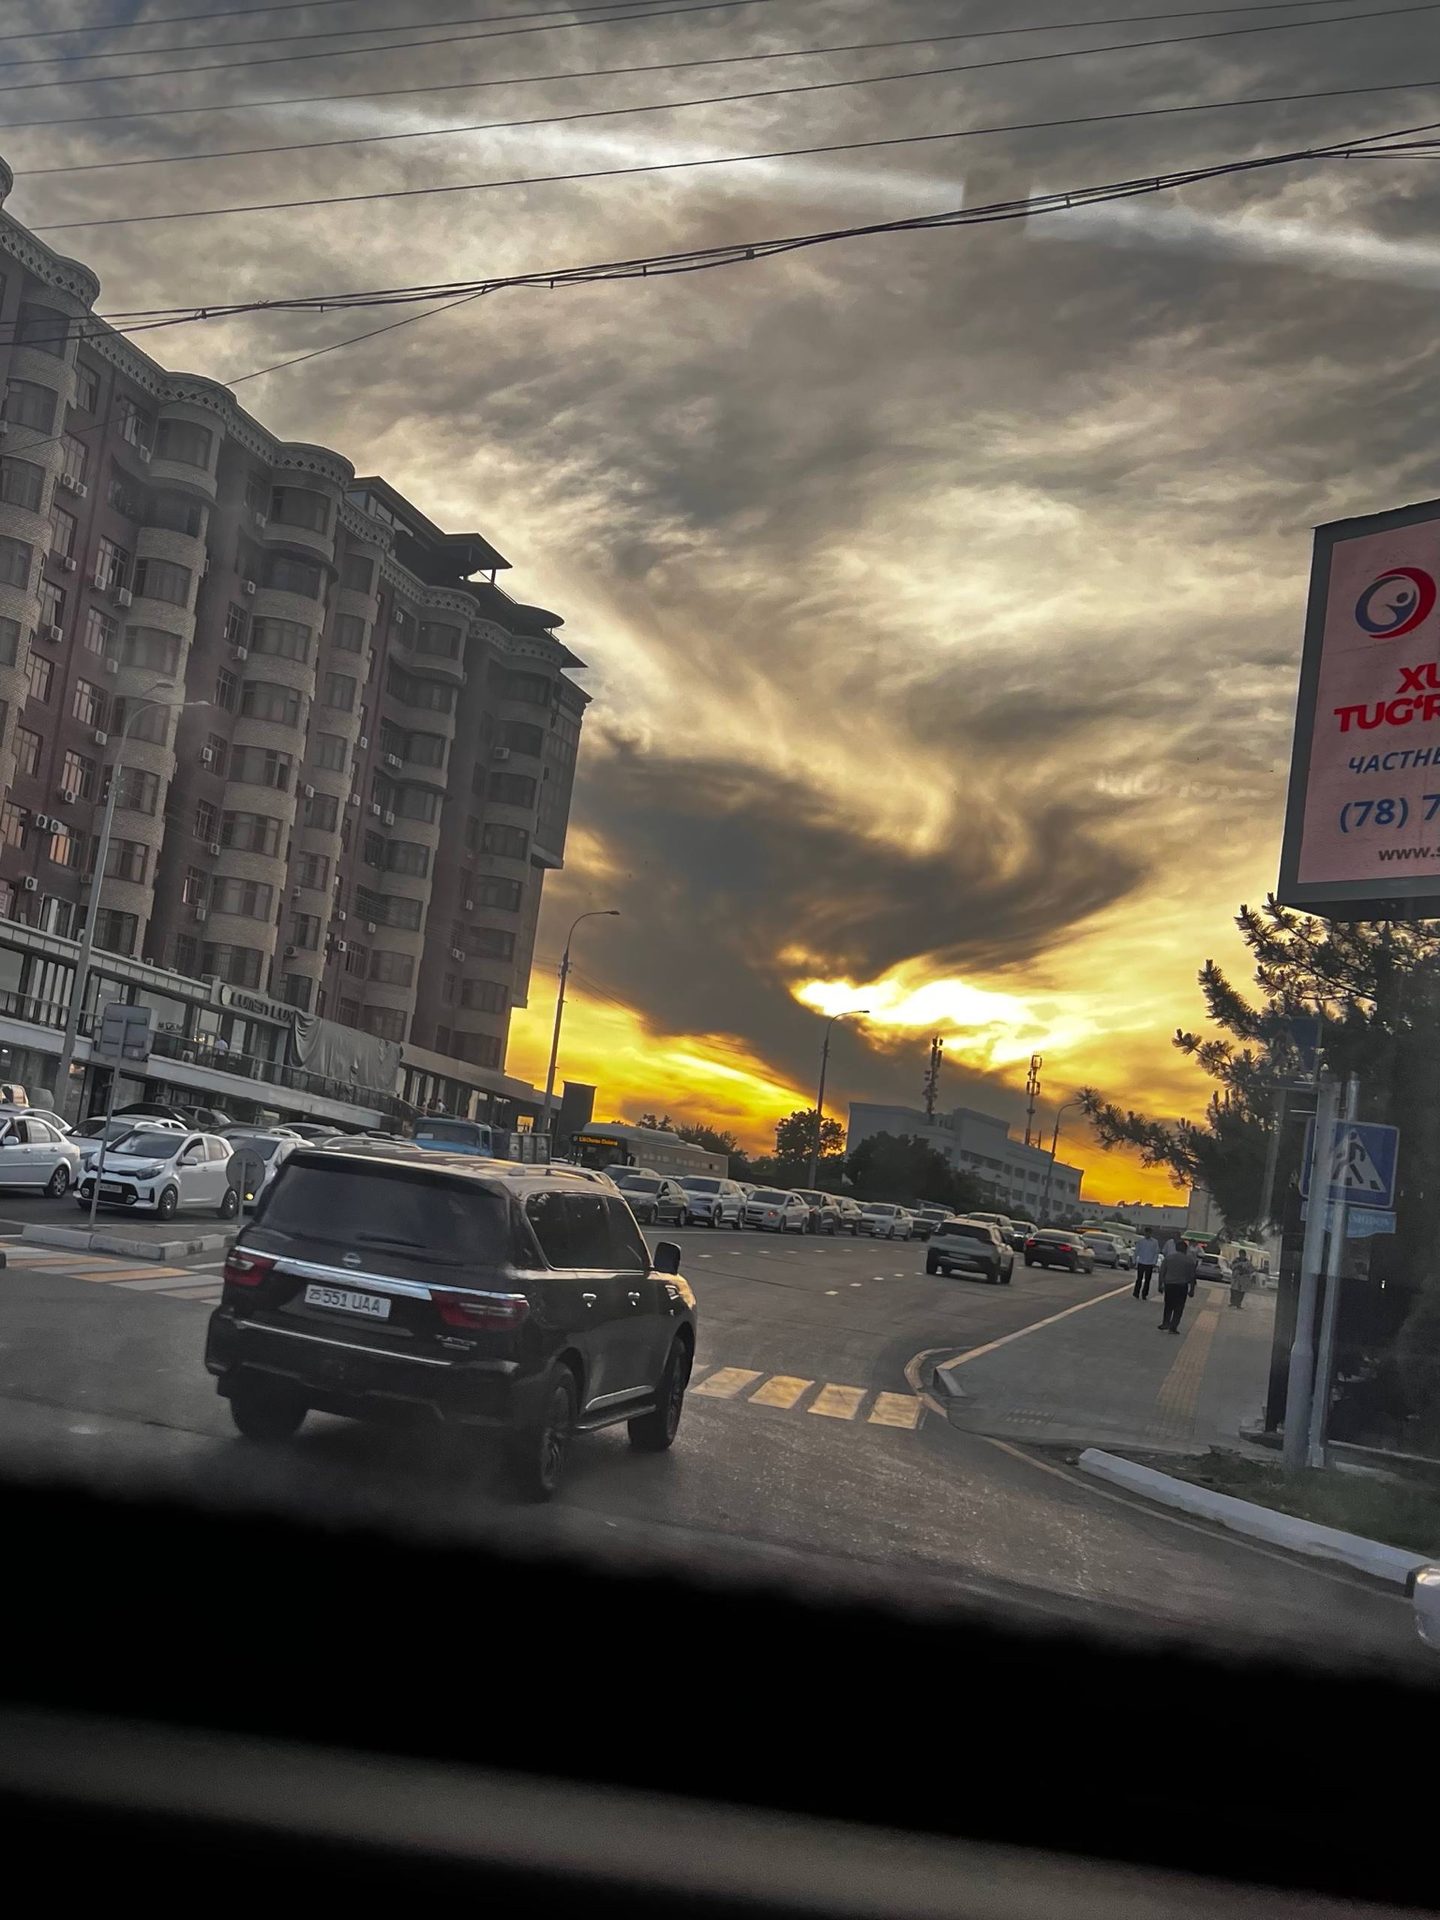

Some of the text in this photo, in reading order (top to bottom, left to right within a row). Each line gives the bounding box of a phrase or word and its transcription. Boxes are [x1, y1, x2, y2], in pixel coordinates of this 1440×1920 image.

[1339, 793, 1440, 833] (78) 7
[322, 1289, 347, 1307] 551
[352, 1295, 380, 1313] UAA
